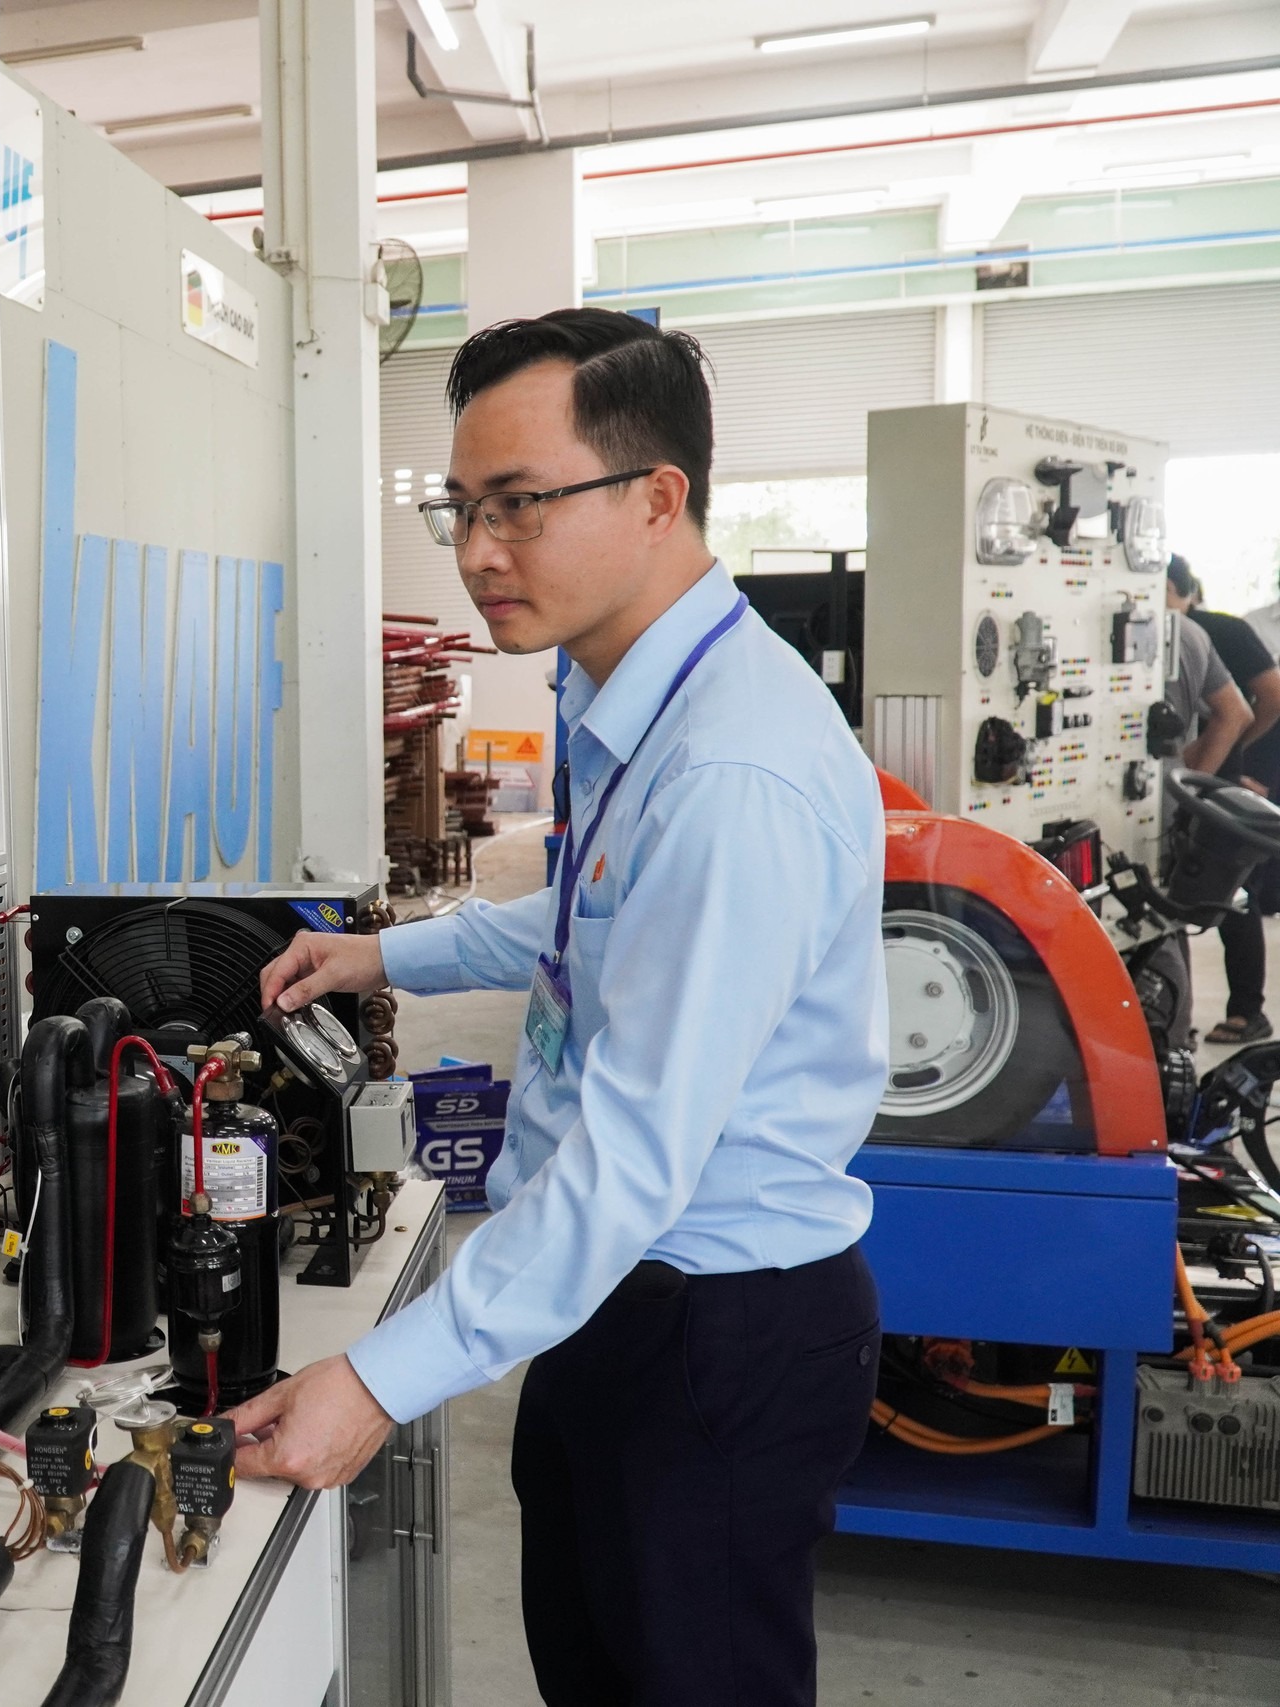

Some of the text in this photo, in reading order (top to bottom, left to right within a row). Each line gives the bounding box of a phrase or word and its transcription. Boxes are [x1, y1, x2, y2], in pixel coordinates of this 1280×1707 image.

[230, 308, 242, 333] CAO
[36, 337, 285, 896] KNAUF
[421, 1137, 485, 1171] GS
[34, 1446, 64, 1455] HONGSEN
[180, 1465, 212, 1475] HONGSEN
